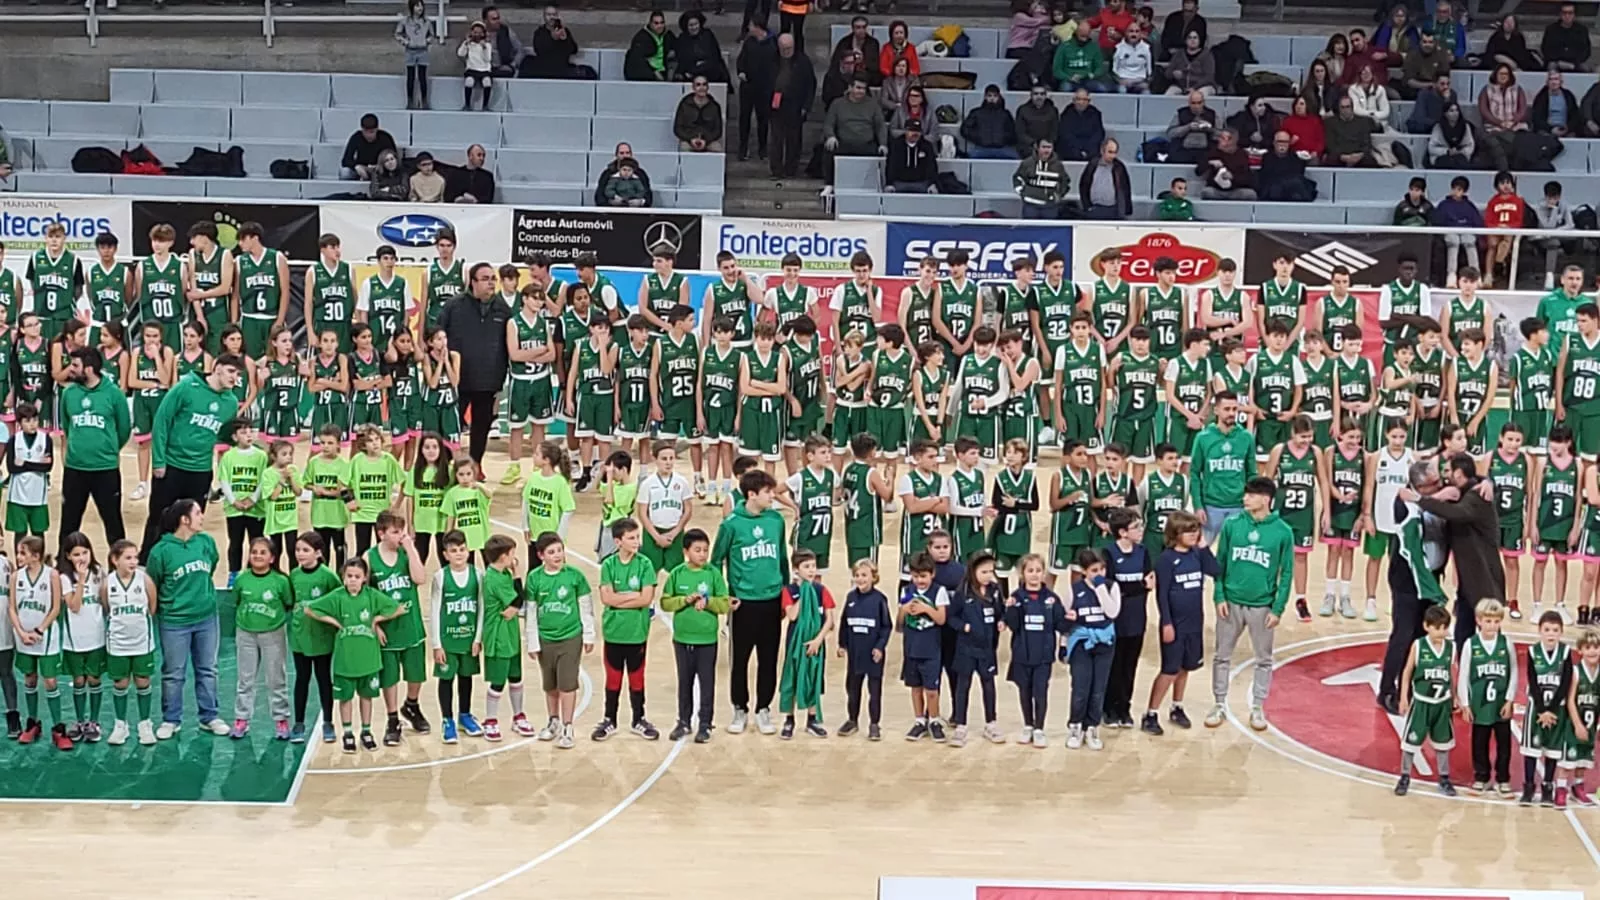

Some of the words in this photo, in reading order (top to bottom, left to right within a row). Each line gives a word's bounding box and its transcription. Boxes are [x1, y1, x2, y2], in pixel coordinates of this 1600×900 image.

[518, 215, 557, 230] Ágreda
[558, 218, 614, 231] Automóvil
[518, 231, 591, 244] Concesionario
[720, 224, 868, 257] Fontecabras
[1146, 238, 1172, 247] 1876
[518, 246, 597, 259] Mercedes-Benz
[47, 291, 57, 311] 8
[152, 298, 174, 317] 00
[256, 291, 267, 311] 6
[104, 305, 111, 321] 1
[323, 302, 344, 321] 30
[379, 314, 396, 334] 14
[951, 319, 966, 338] 12
[1047, 320, 1069, 338] 32
[1103, 319, 1121, 338] 57
[1157, 325, 1175, 345] 16
[396, 381, 412, 396] 26
[630, 383, 644, 402] 11
[672, 376, 694, 396] 25
[1075, 385, 1093, 405] 13
[1573, 377, 1596, 399] 88
[279, 391, 288, 406] 2
[880, 392, 892, 407] 9
[1133, 389, 1145, 409] 5
[1270, 392, 1282, 413] 3
[1461, 399, 1481, 414] 77
[359, 473, 387, 484] AMYPA
[1285, 490, 1306, 508] 23
[1500, 491, 1511, 508] 5
[1552, 499, 1563, 516] 3
[812, 514, 830, 535] 70
[1004, 513, 1016, 535] 0
[1076, 508, 1084, 526] 7
[1432, 684, 1444, 698] 7
[1486, 681, 1497, 701] 6
[1584, 711, 1595, 728] 9
